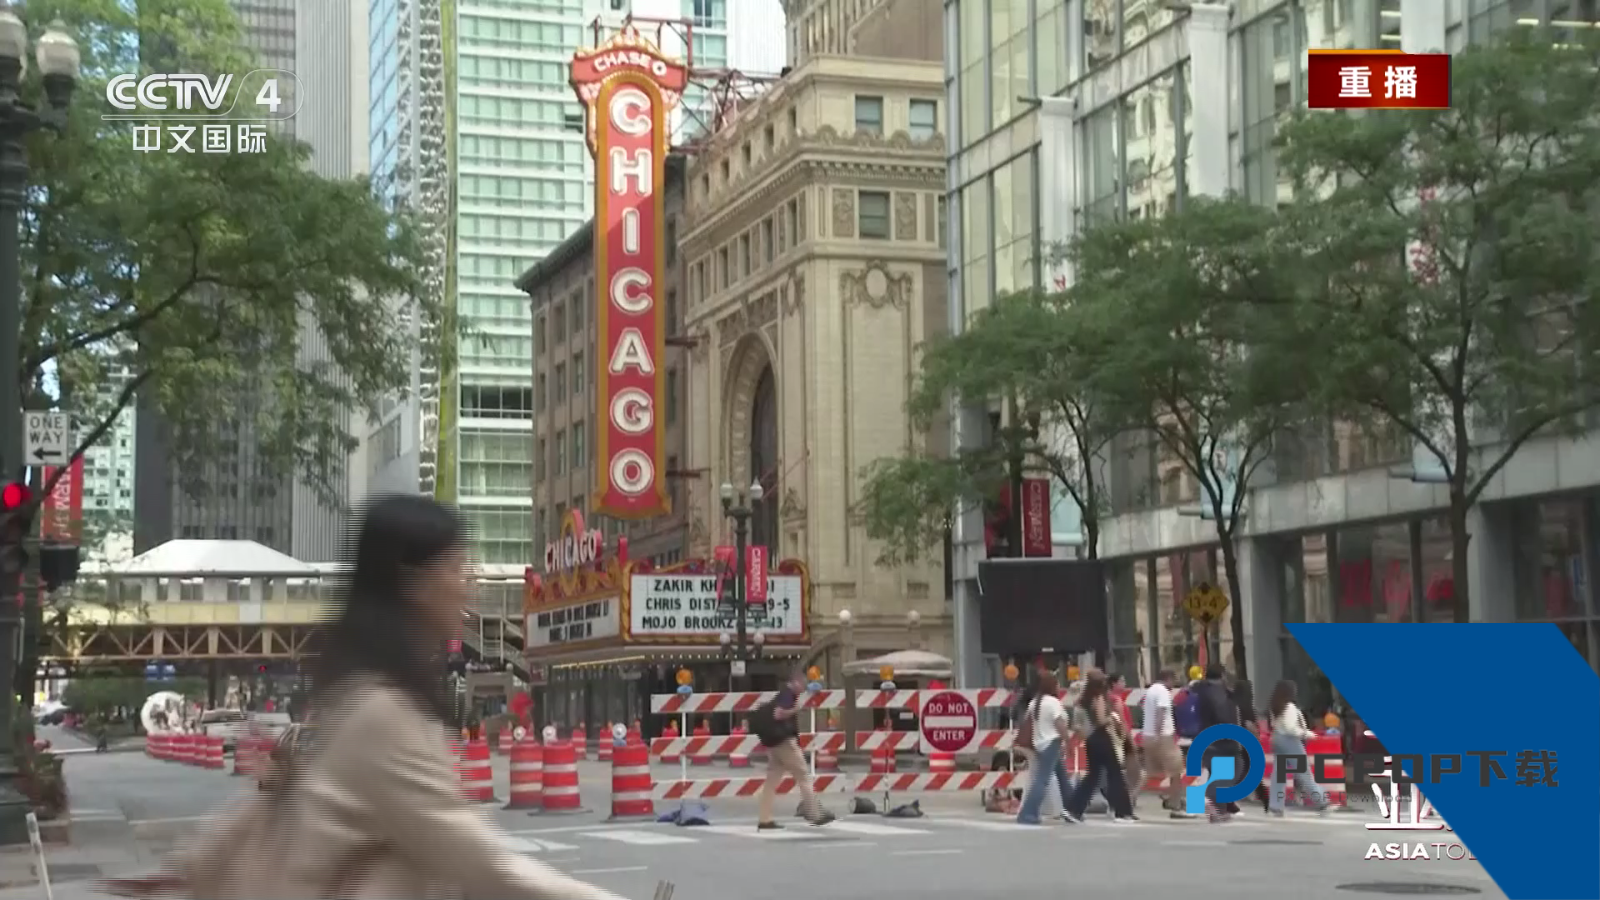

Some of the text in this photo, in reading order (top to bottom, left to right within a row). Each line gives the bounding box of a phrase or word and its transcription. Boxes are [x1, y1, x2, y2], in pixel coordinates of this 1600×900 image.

[594, 50, 651, 71] CHASE
[608, 88, 655, 496] CHICAGO
[30, 416, 62, 429] ONE
[30, 432, 63, 444] WAY
[545, 528, 596, 573] CHICAGO
[654, 579, 693, 592] ZAKIR
[645, 598, 682, 611] CHRIS
[689, 598, 717, 611] DIST
[642, 616, 676, 629] MOJO
[684, 616, 734, 629] BROOKZ
[929, 702, 969, 713] DO NOT
[933, 729, 966, 741] ENTER
